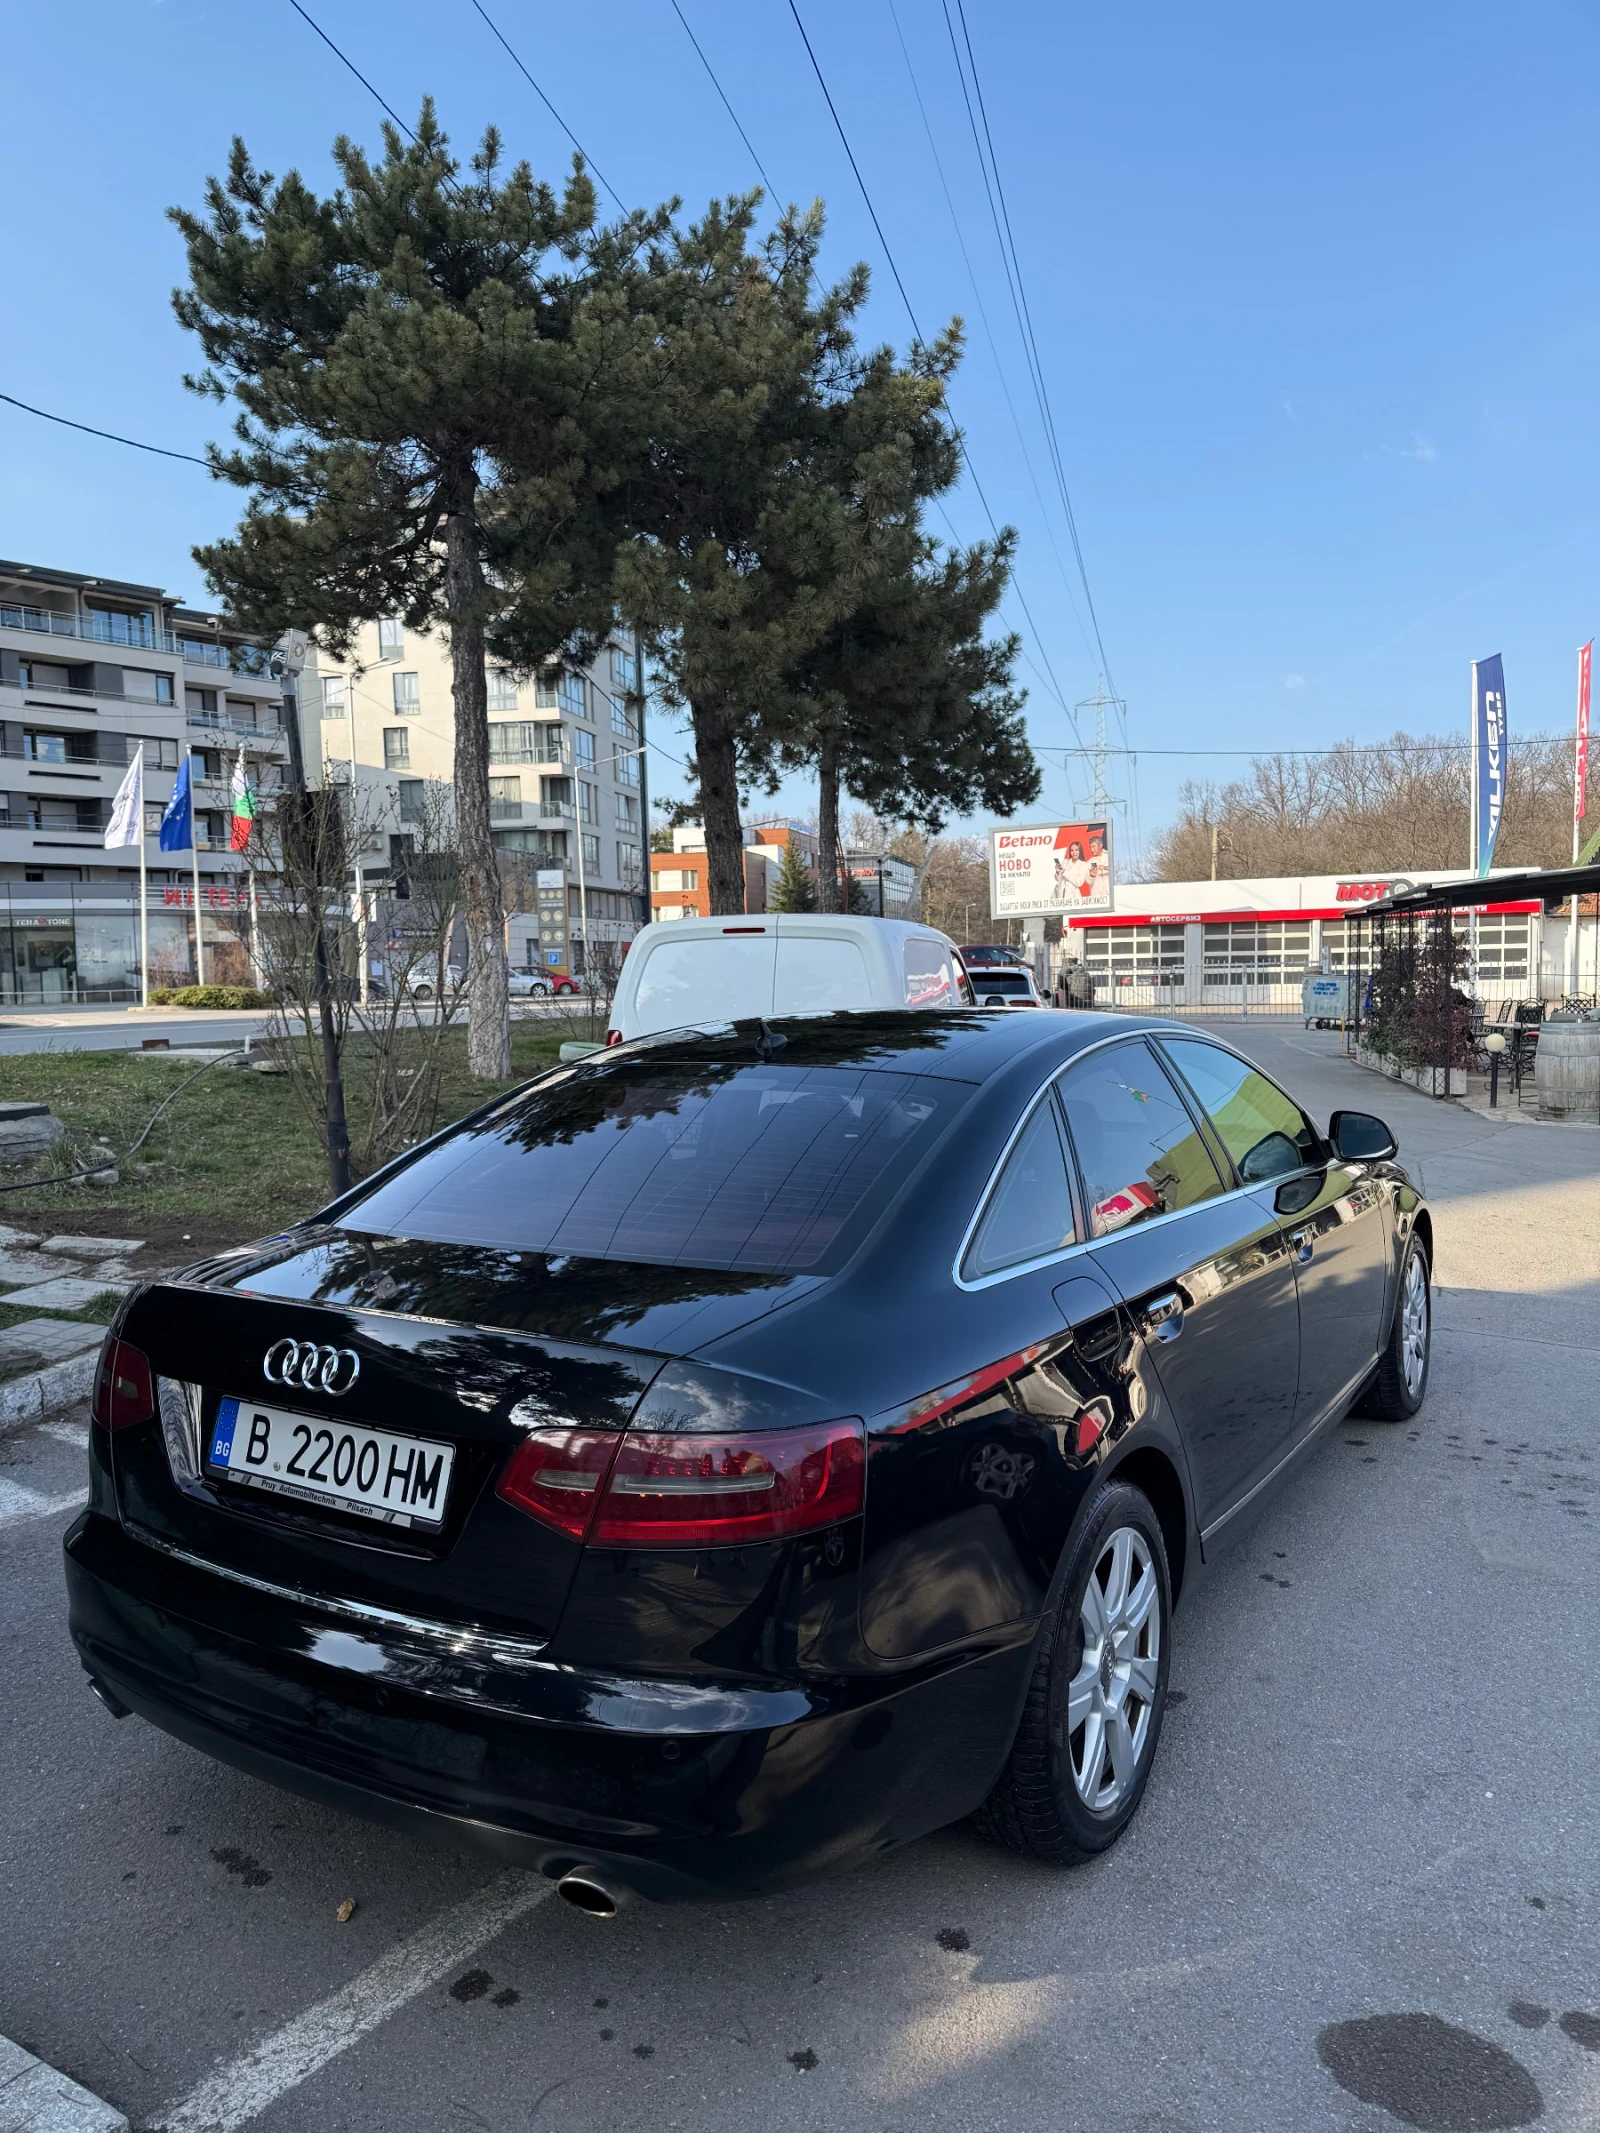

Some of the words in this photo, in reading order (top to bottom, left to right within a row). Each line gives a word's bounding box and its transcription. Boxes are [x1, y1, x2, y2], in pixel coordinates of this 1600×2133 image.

[1486, 691, 1501, 846] ALKEN
[999, 835, 1052, 848] Betano
[999, 858, 1031, 872] НОВО
[1150, 915, 1201, 923] АВТОСЕРВИЗ
[213, 1440, 231, 1458] BG
[245, 1413, 271, 1466] B
[286, 1424, 380, 1493] 2200
[383, 1443, 445, 1510] HM
[261, 1478, 277, 1493] Pruy
[278, 1482, 338, 1507] Automobiltechnik
[345, 1501, 374, 1517] Pilsach
